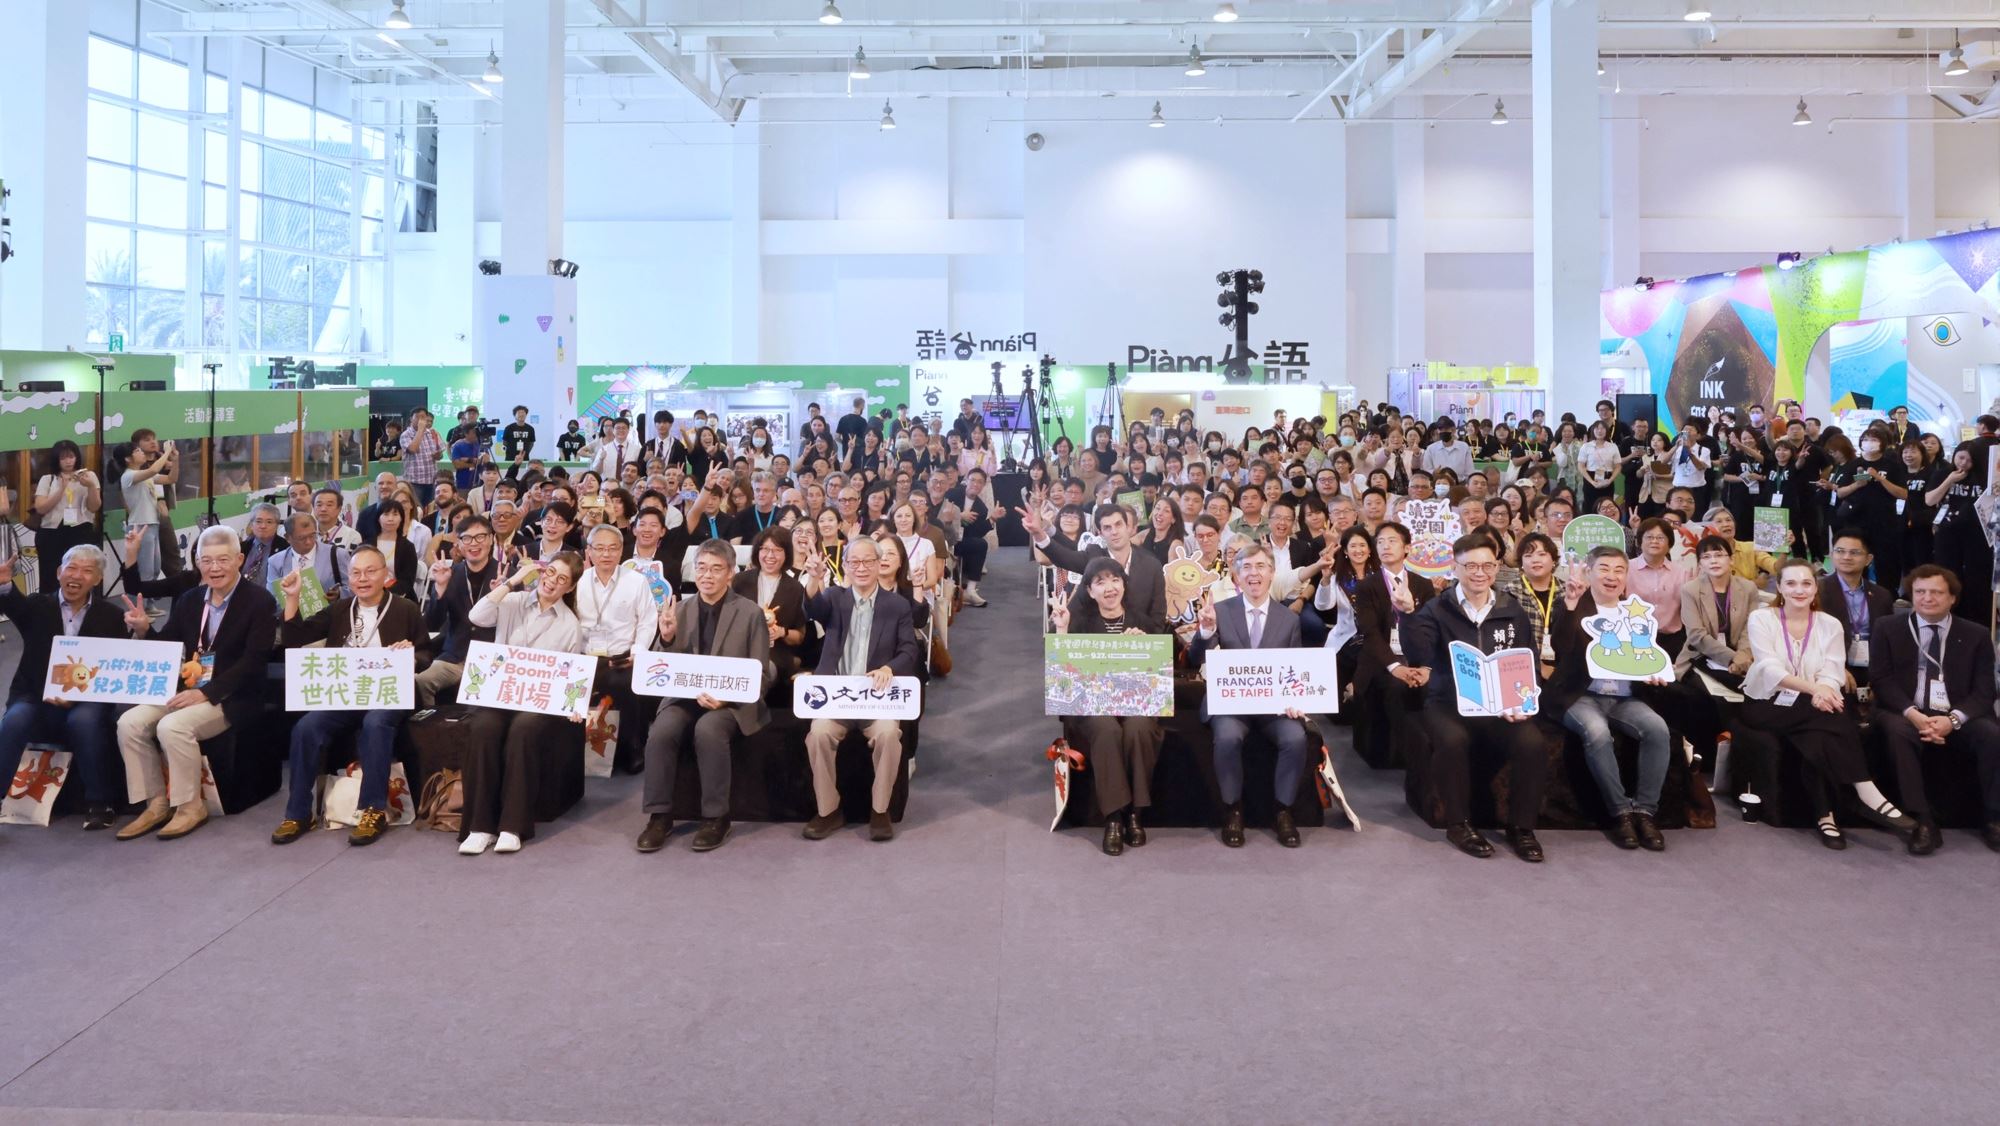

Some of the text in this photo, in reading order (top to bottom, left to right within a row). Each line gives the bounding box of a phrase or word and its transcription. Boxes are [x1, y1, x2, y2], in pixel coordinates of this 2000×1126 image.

[1700, 381, 1725, 399] INK
[300, 652, 348, 680] 未來
[508, 647, 557, 667] Young
[1229, 666, 1272, 675] BUREAU
[93, 674, 168, 697] 兒少影展
[673, 672, 750, 692] 高雄市政府
[1216, 677, 1273, 687] FRANÇAIS
[496, 676, 551, 711] 劇場
[832, 686, 912, 703] 文化部
[1222, 688, 1273, 698] DE TAIPEI
